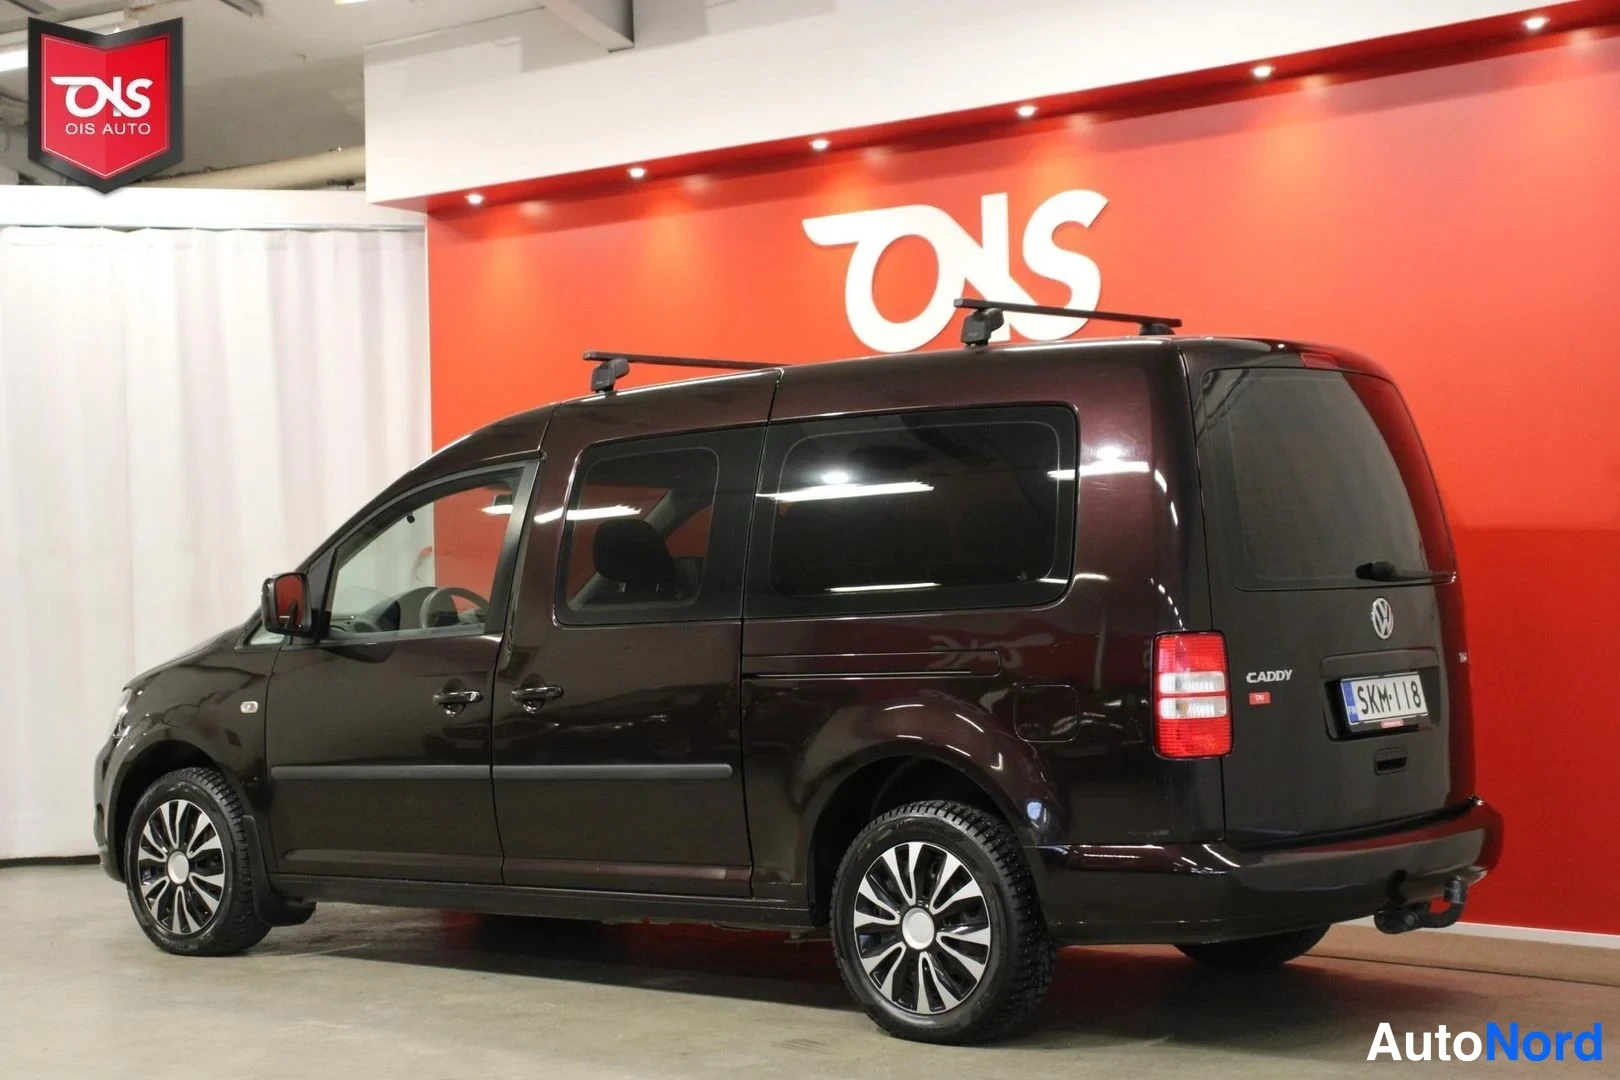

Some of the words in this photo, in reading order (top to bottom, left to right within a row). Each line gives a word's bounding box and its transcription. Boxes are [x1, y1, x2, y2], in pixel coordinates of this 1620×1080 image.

[801, 189, 1110, 353] OIS
[1246, 669, 1293, 684] CADDY
[1357, 680, 1422, 715] SKM-118
